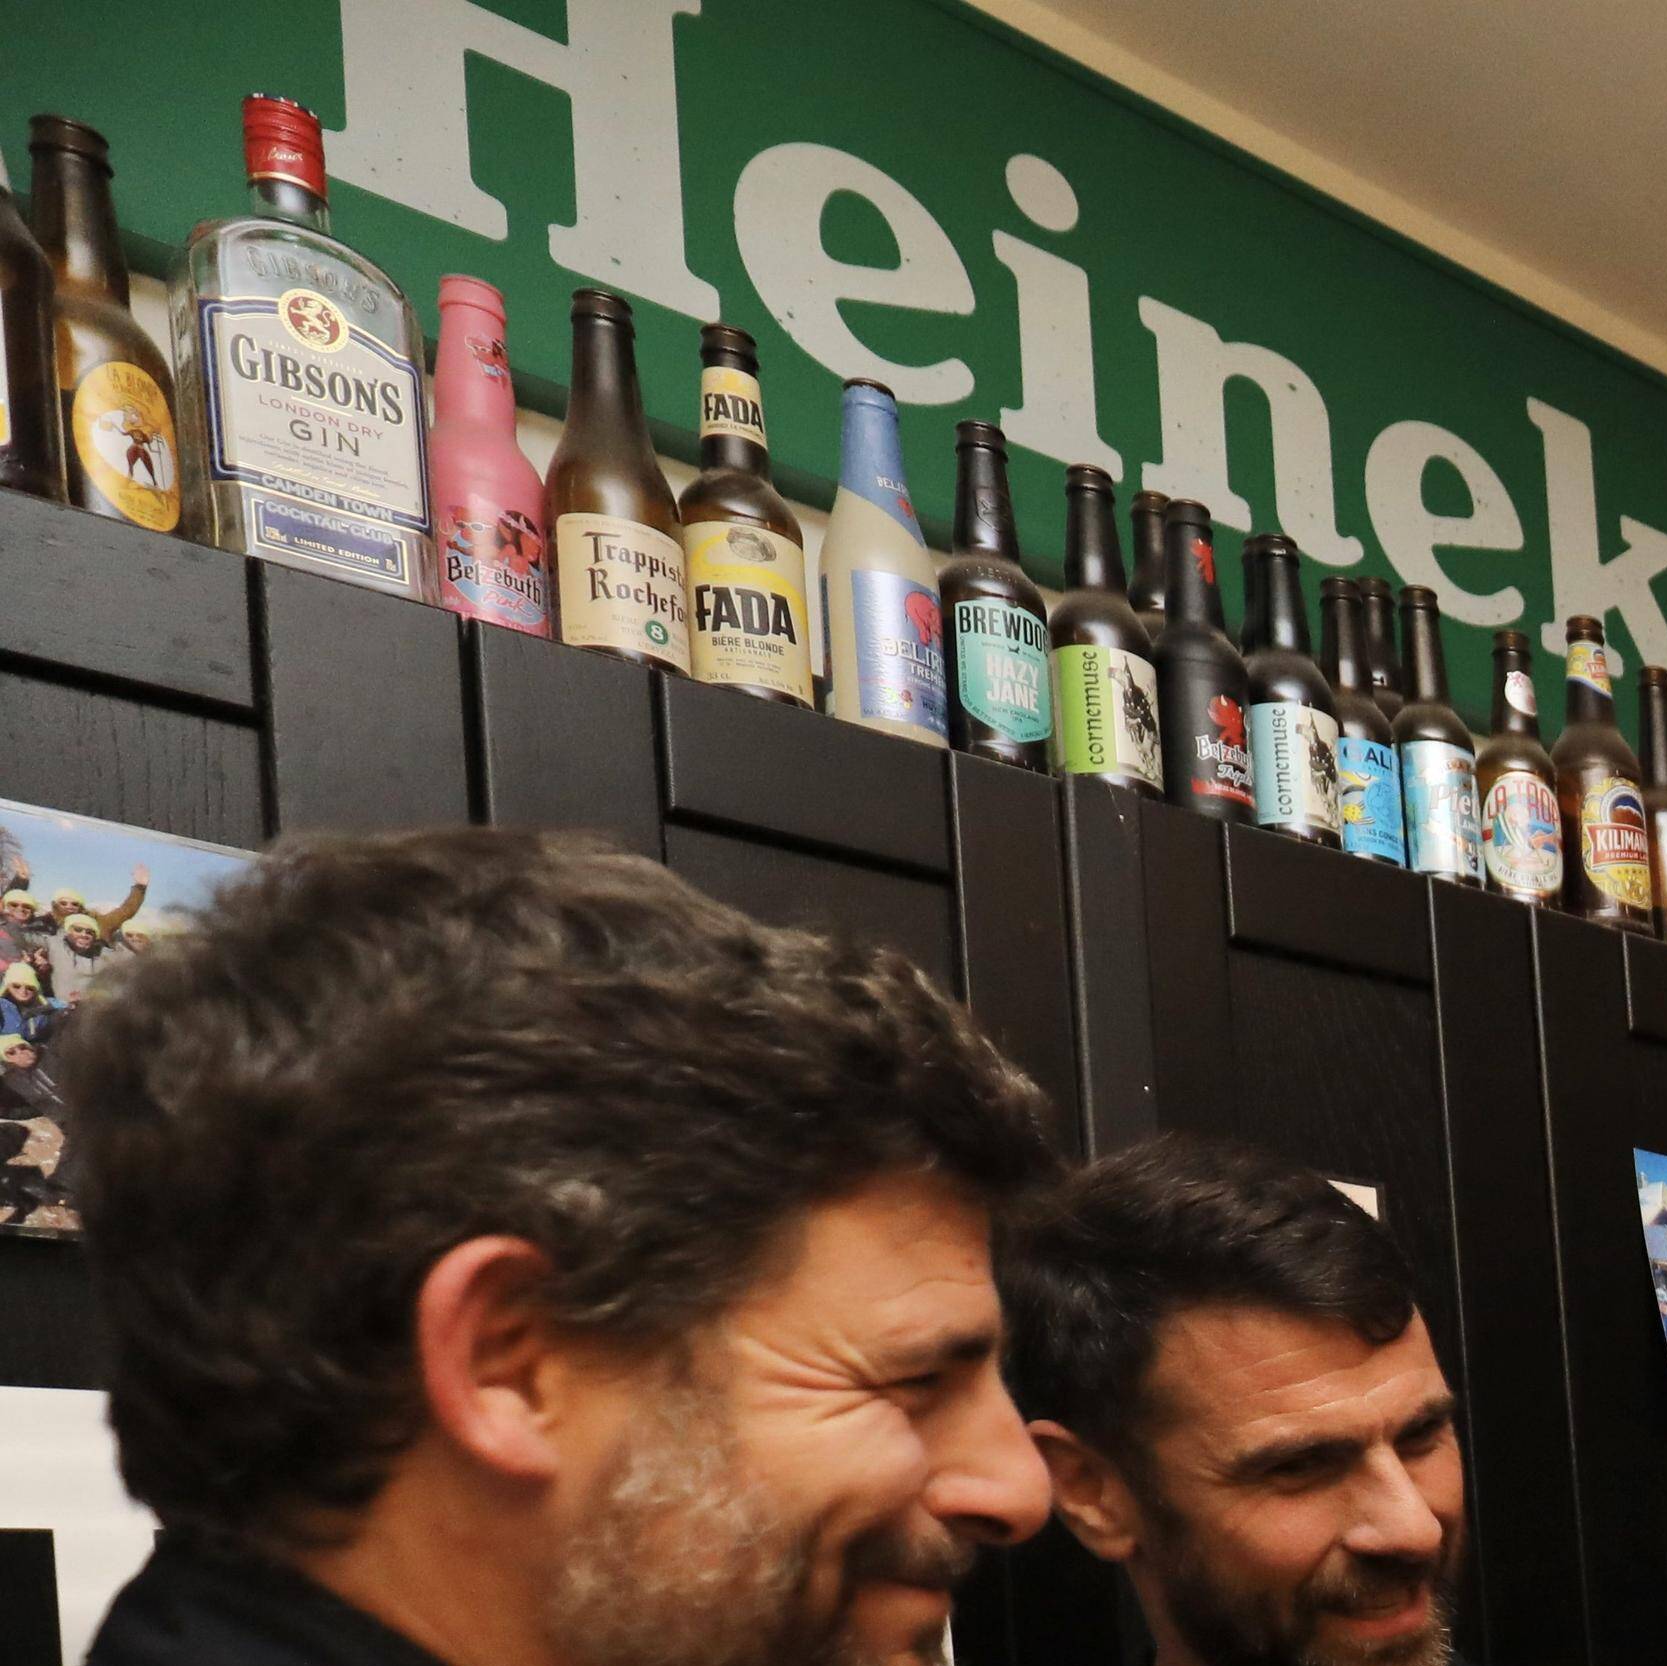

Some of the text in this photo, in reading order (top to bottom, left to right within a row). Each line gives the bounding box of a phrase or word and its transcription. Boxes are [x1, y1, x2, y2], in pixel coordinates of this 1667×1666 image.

[230, 333, 404, 425] GIBSON'S
[258, 394, 384, 440] LONDON DRY
[704, 392, 764, 434] FADA
[289, 418, 361, 457] GIN
[261, 474, 394, 522] CAMDEN TOWN
[265, 500, 395, 545] COCKTAIL CLUB
[293, 536, 335, 554] LIMITED
[338, 548, 380, 566] EDITION
[650, 624, 664, 641] 8
[694, 584, 797, 645] FADA
[744, 639, 785, 657] BLONDE
[985, 652, 1040, 690] HAZY
[986, 680, 1040, 713] JANE
[1081, 650, 1105, 766] cornemuse
[1271, 708, 1294, 817] cornemuse
